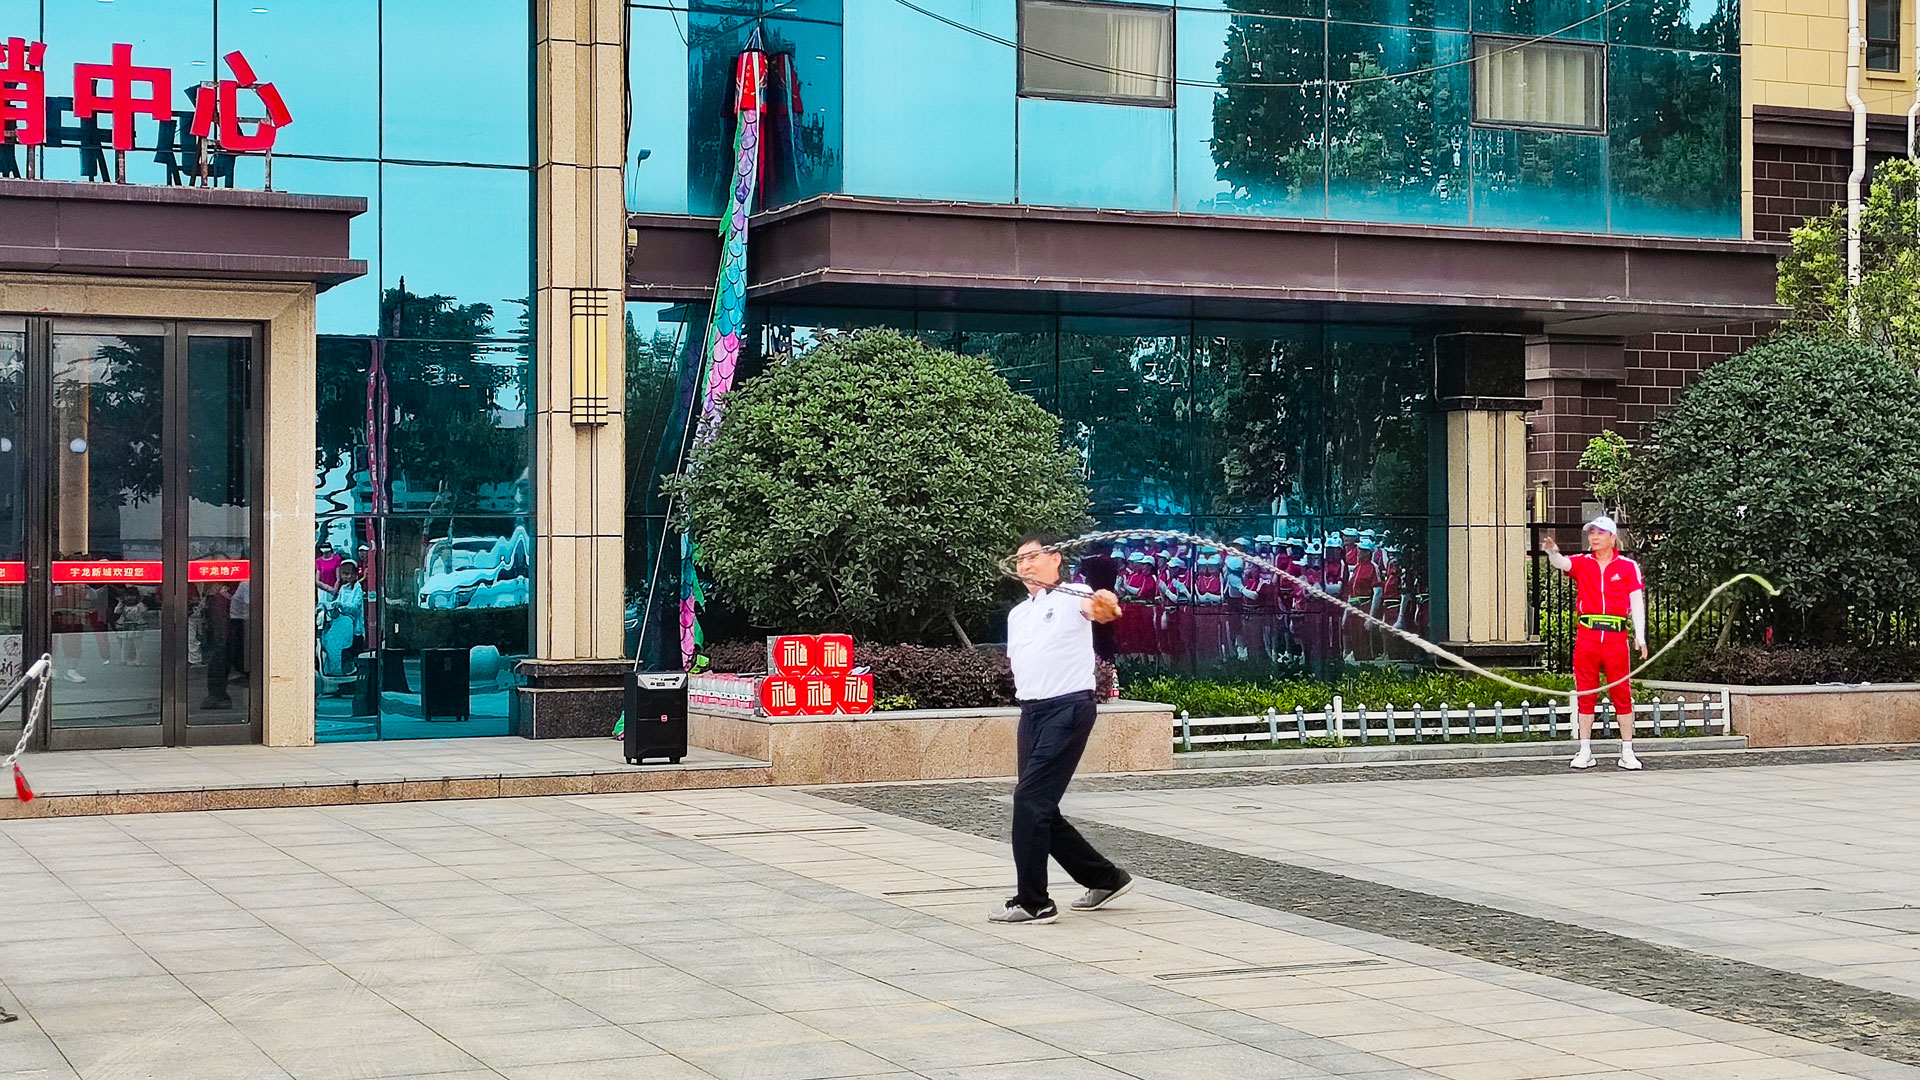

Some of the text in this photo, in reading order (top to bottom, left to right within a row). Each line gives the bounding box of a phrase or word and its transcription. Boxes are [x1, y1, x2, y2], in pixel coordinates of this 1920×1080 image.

[70, 567, 144, 577] 宇龙新城欢迎您
[199, 566, 240, 576] 宇龙地产
[783, 641, 808, 666] 礼
[824, 641, 847, 667] 礼
[771, 681, 796, 707] 礼
[807, 680, 832, 706] 礼
[844, 676, 868, 703] 礼
